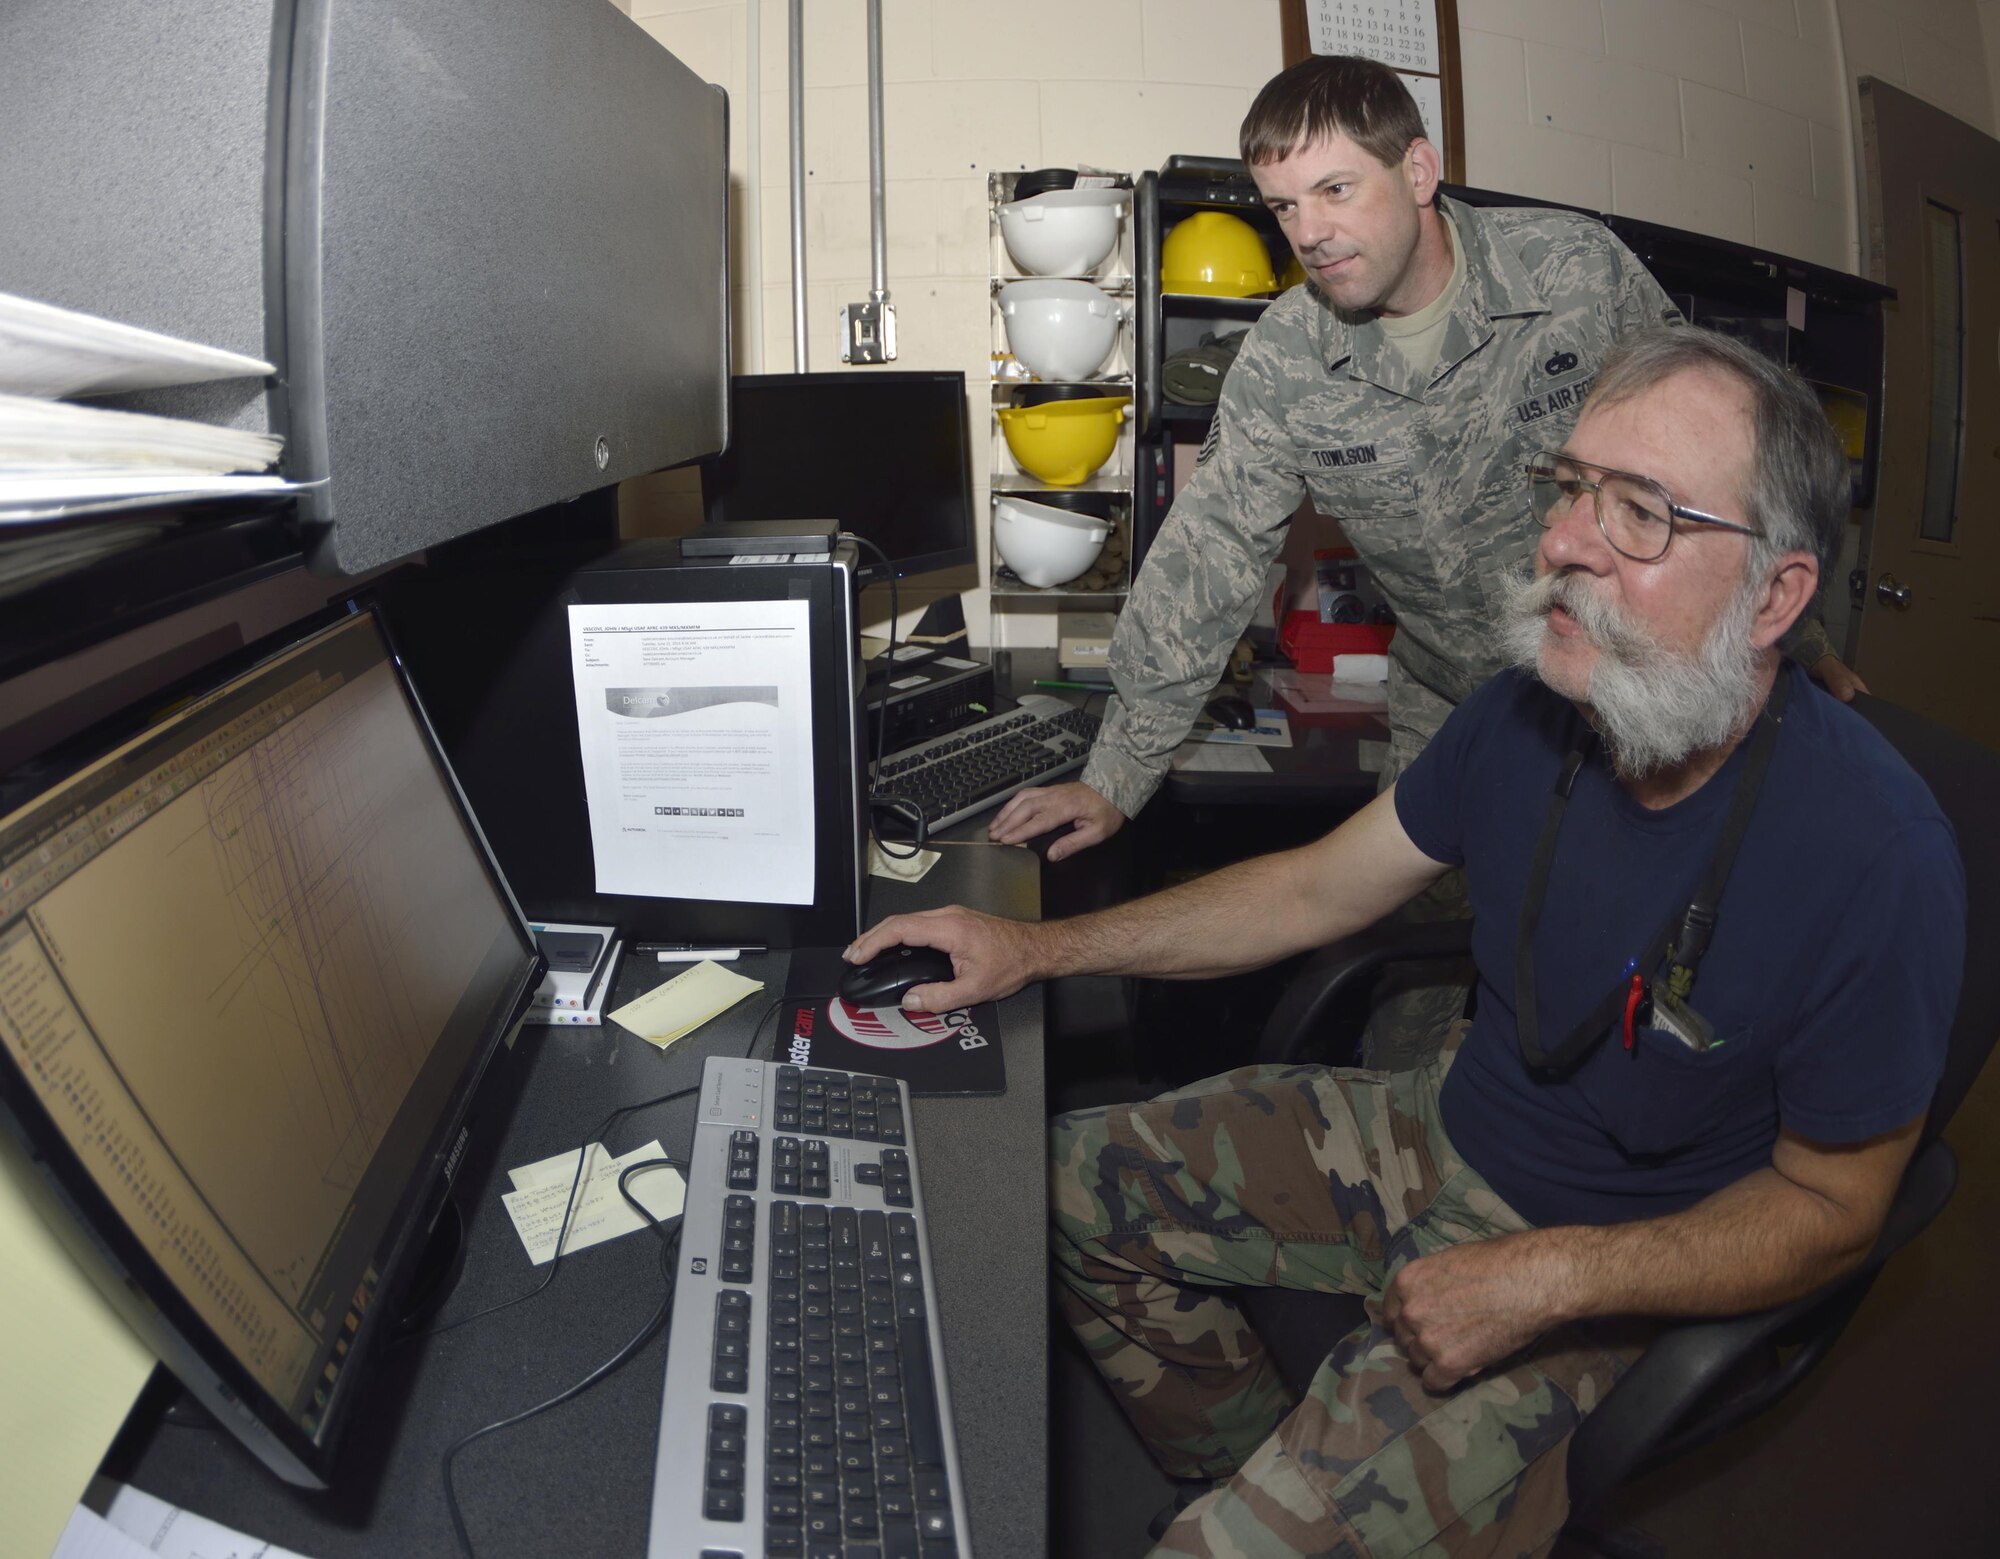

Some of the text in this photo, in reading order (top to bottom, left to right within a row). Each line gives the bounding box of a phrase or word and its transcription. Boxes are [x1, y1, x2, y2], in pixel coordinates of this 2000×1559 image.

[1321, 0, 1421, 23] 3 4 5 6 7 8 9
[1414, 0, 1420, 9] 2
[1320, 12, 1425, 37] 10 11 12 13 14 15 16
[1321, 27, 1425, 51] 17 18 19 20 21 22 23
[1321, 40, 1427, 66] 24 25 26 27 28 29 30
[1420, 101, 1426, 111] 7
[1517, 400, 1547, 422] U.S.
[1547, 388, 1575, 413] AIR
[1312, 445, 1377, 467] TOWLSON
[623, 696, 655, 705] Delcam
[443, 1126, 469, 1182] SAMSUNG
[812, 1492, 823, 1500] W
[851, 1517, 863, 1525] A
